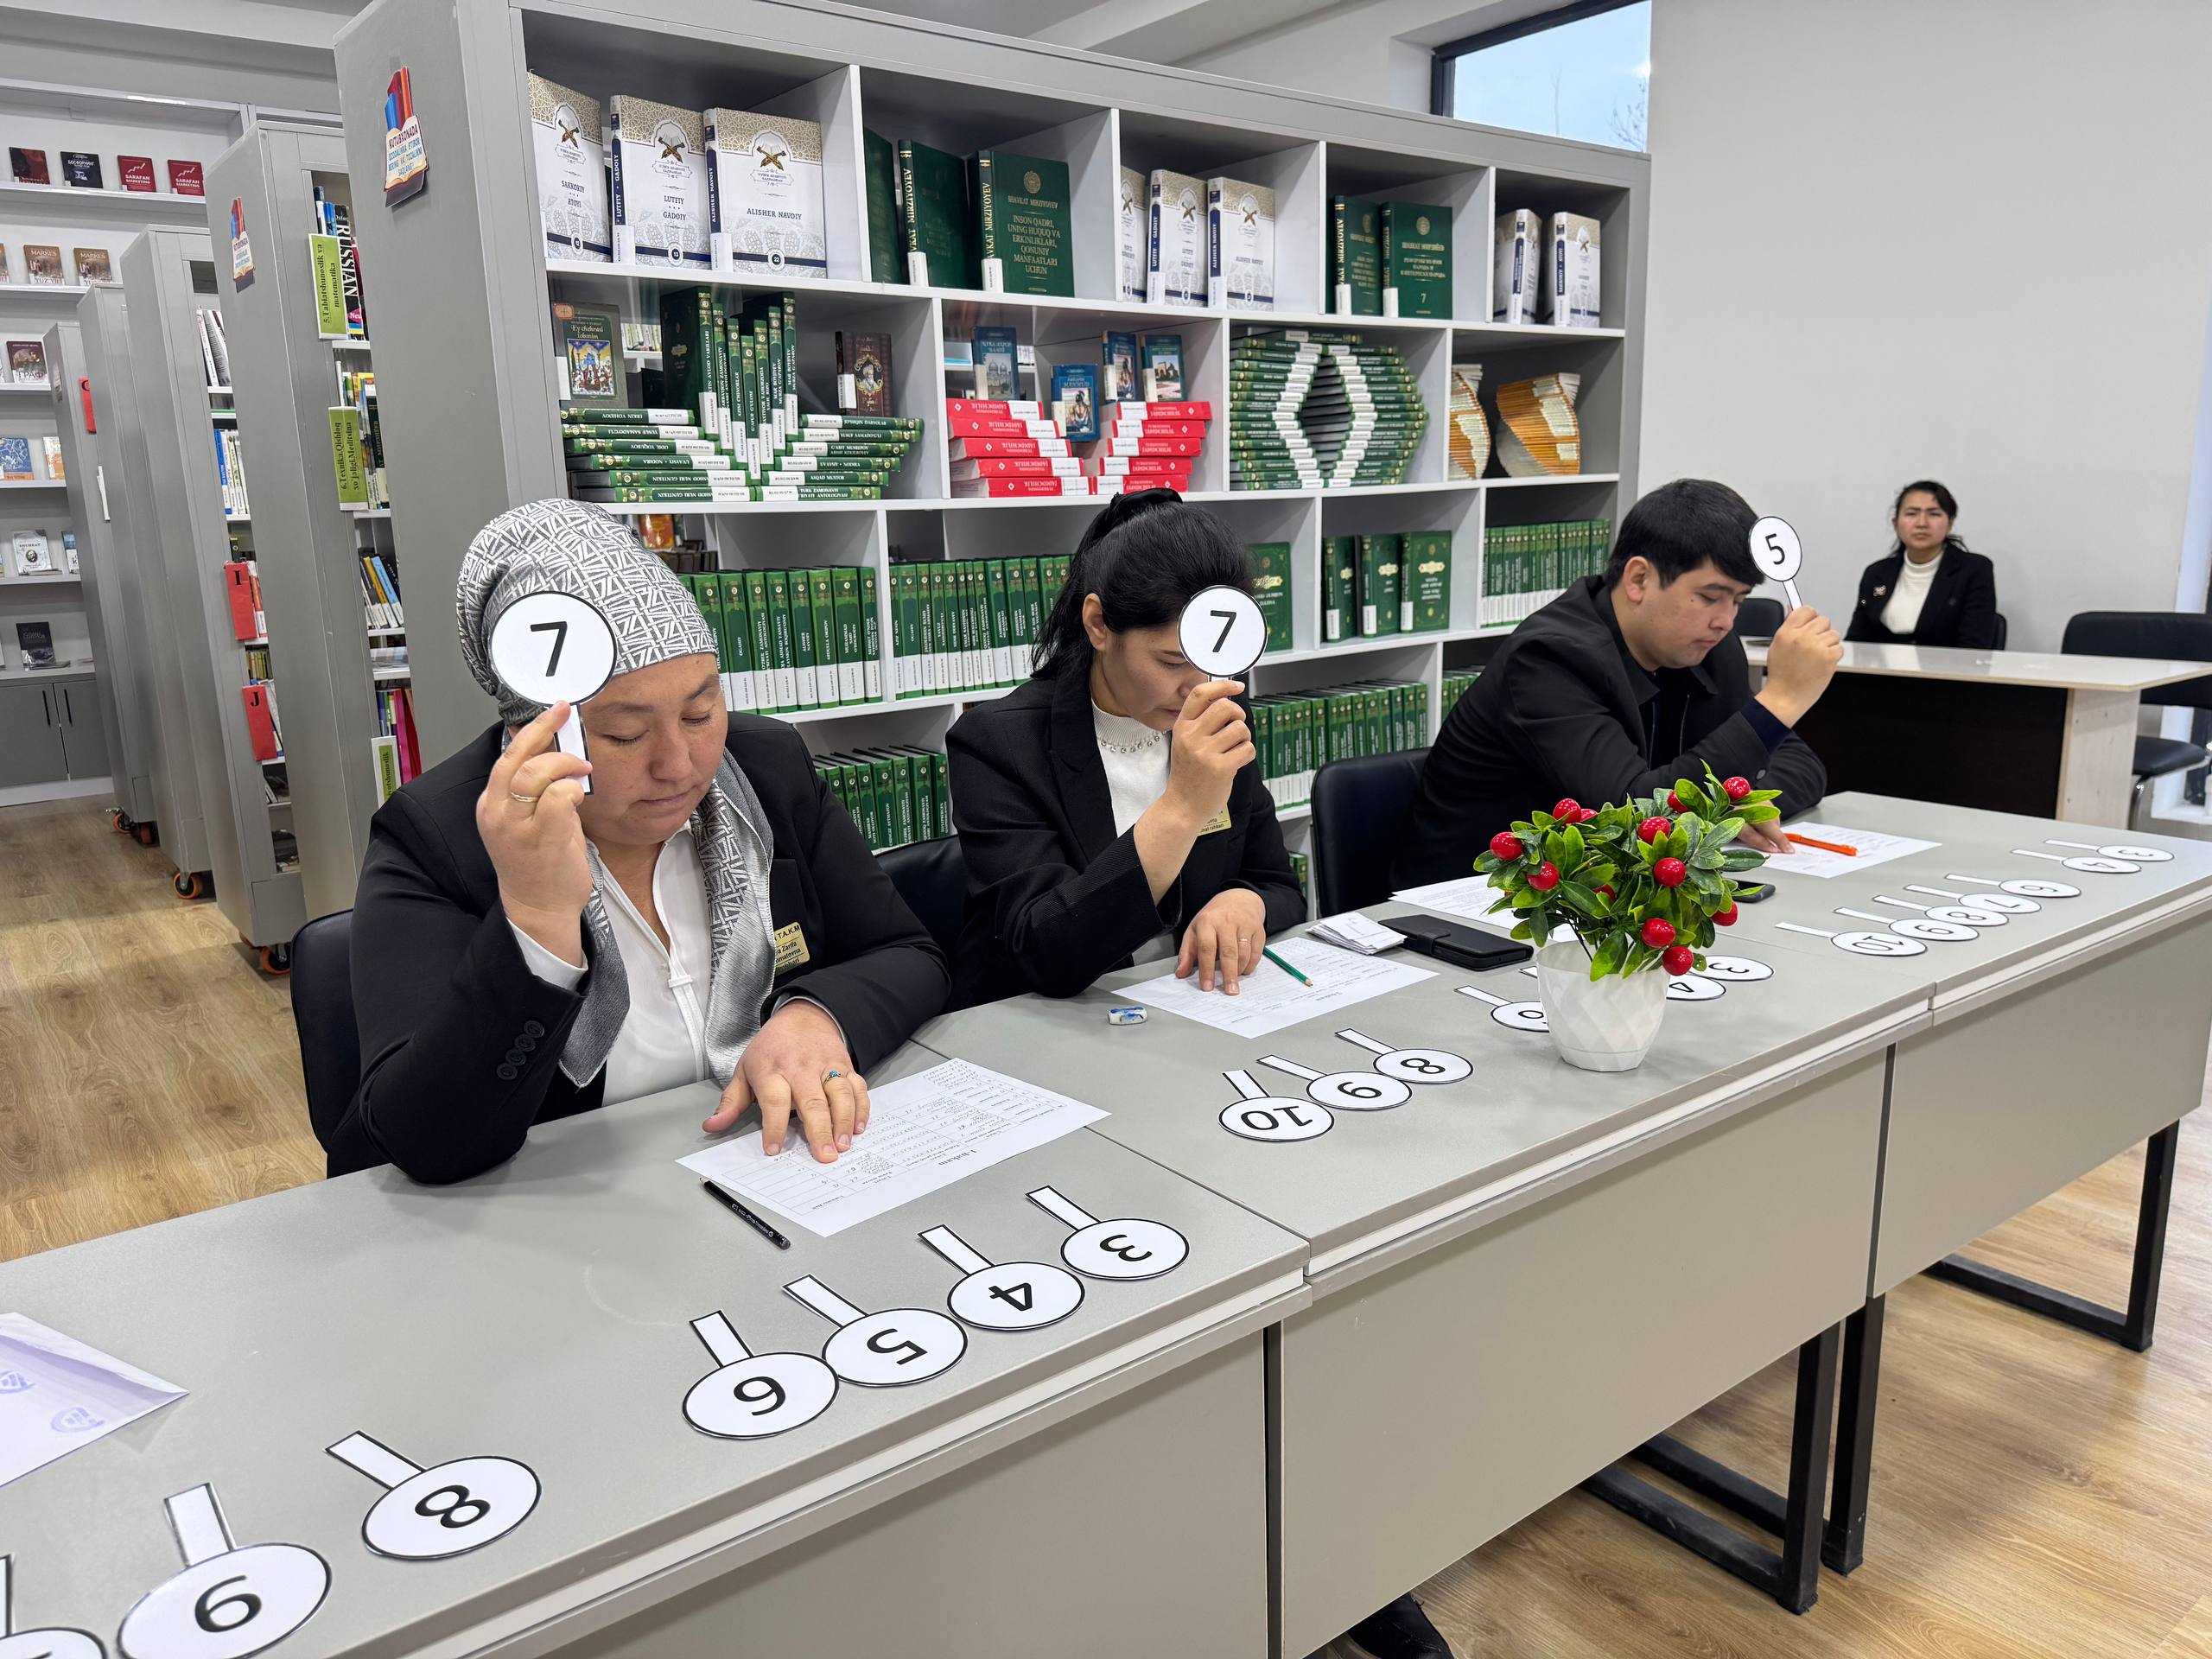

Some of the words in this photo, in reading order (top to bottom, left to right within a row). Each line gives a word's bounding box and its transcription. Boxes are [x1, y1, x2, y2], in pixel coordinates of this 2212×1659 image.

[664, 195, 684, 205] LUTFIY
[903, 168, 915, 223] MIRZIYOYEV
[664, 211, 686, 220] GADOIY
[747, 208, 776, 218] ALISHER
[778, 211, 802, 220] NAVOIY
[982, 183, 992, 233] MIRZIYOYEV
[1014, 215, 1032, 226] INSON
[1007, 225, 1028, 234] UNING
[1028, 226, 1051, 238] HUQUQ
[316, 244, 323, 253] va
[1021, 246, 1049, 257] QONUNIY
[336, 224, 358, 297] RUSSIAN
[1014, 256, 1058, 266] MANFAATLARI
[1025, 265, 1047, 275] UCHUN
[317, 256, 330, 323] 5.Tabiatshunoslik
[330, 263, 339, 308] matematika
[1766, 532, 1787, 565] 5
[235, 570, 241, 585] I
[1210, 610, 1237, 653] 7
[531, 621, 567, 677] 7
[251, 691, 259, 706] J
[1983, 898, 2021, 909] 7
[1946, 912, 1983, 921] 8
[1913, 925, 1955, 934] 9
[781, 941, 797, 952] Zarifa
[1852, 937, 1904, 952] 10
[1711, 961, 1750, 975] 3
[1400, 1058, 1445, 1075] 8
[1338, 1081, 1382, 1100] 9
[1241, 1106, 1313, 1130] 10
[1099, 1234, 1153, 1262] 3
[988, 1281, 1033, 1311] 4
[867, 1328, 928, 1365] 5
[733, 1376, 786, 1416] 6
[415, 1484, 491, 1529] 8
[195, 1574, 263, 1633] 9
